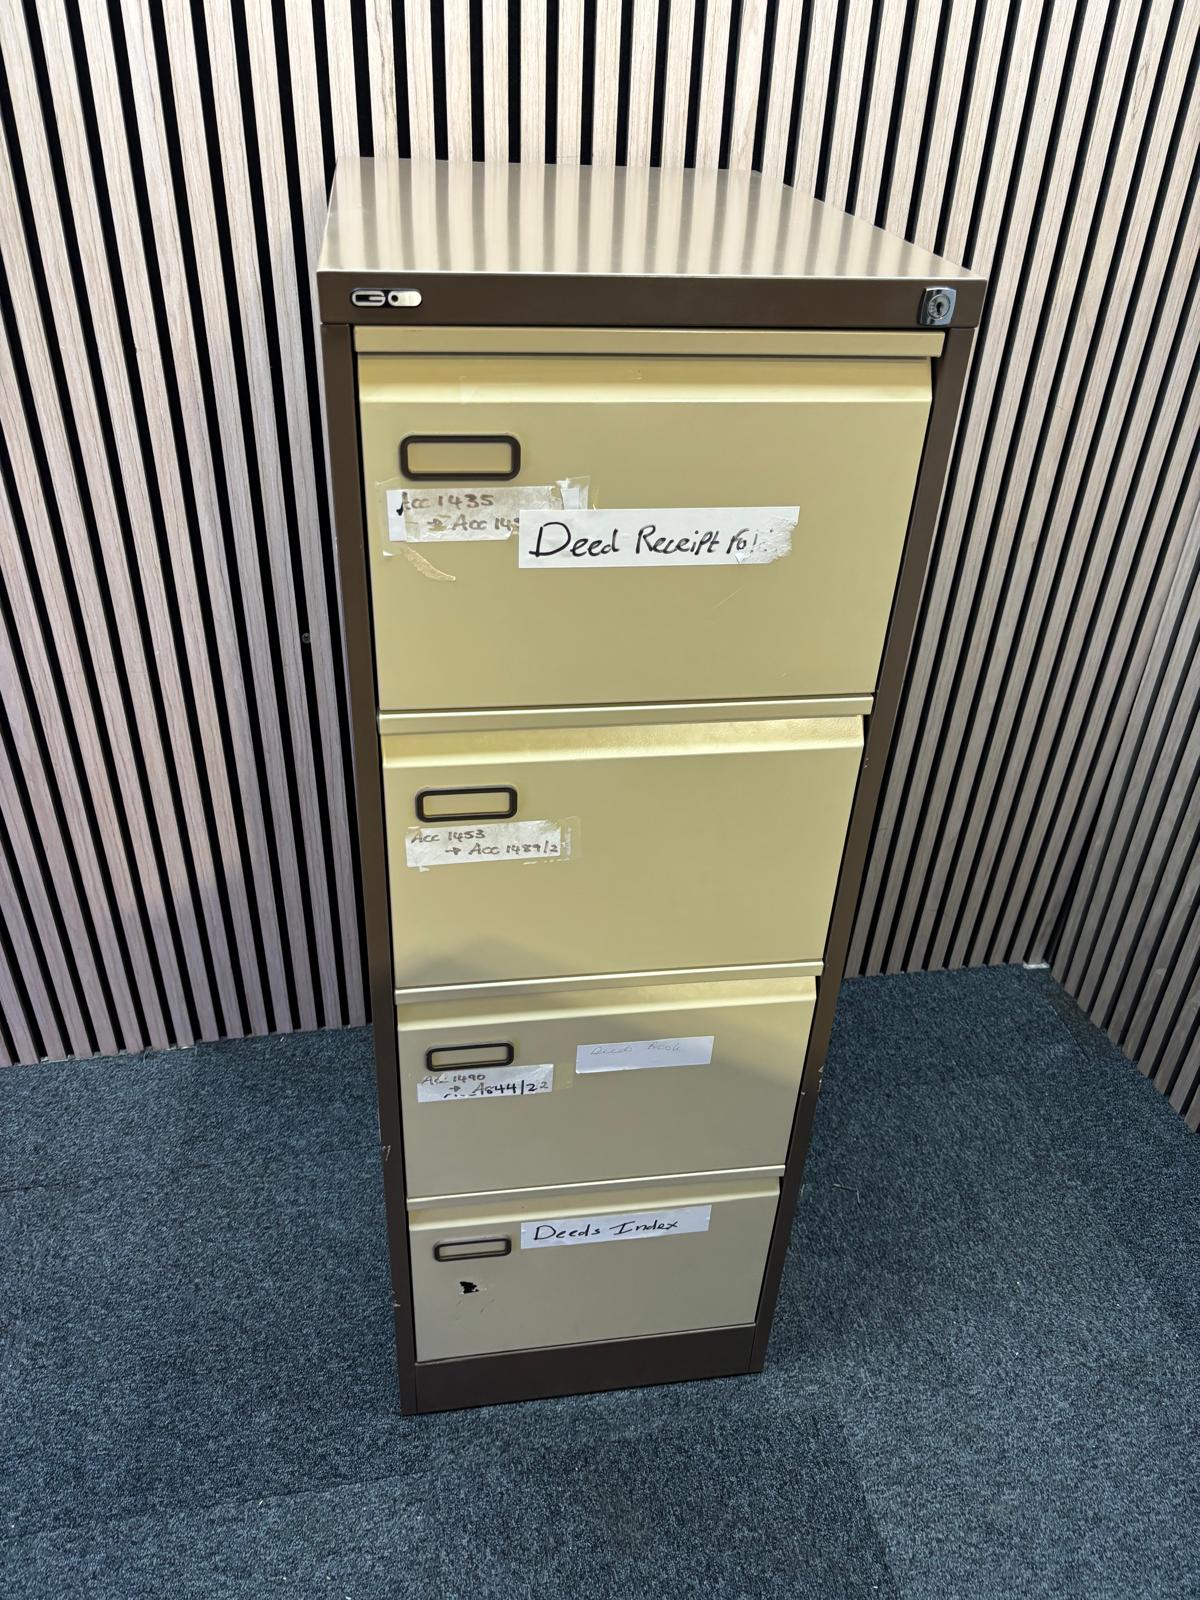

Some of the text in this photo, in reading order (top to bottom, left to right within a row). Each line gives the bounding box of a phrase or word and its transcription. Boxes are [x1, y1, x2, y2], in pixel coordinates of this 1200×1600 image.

[437, 494, 494, 510] 1435
[449, 514, 488, 531] Acc
[529, 521, 620, 558] Deed
[636, 524, 720, 556] Receipt
[411, 829, 486, 843] Acc 1453
[468, 843, 500, 855] Acc
[533, 1219, 678, 1241] Deeds Index
